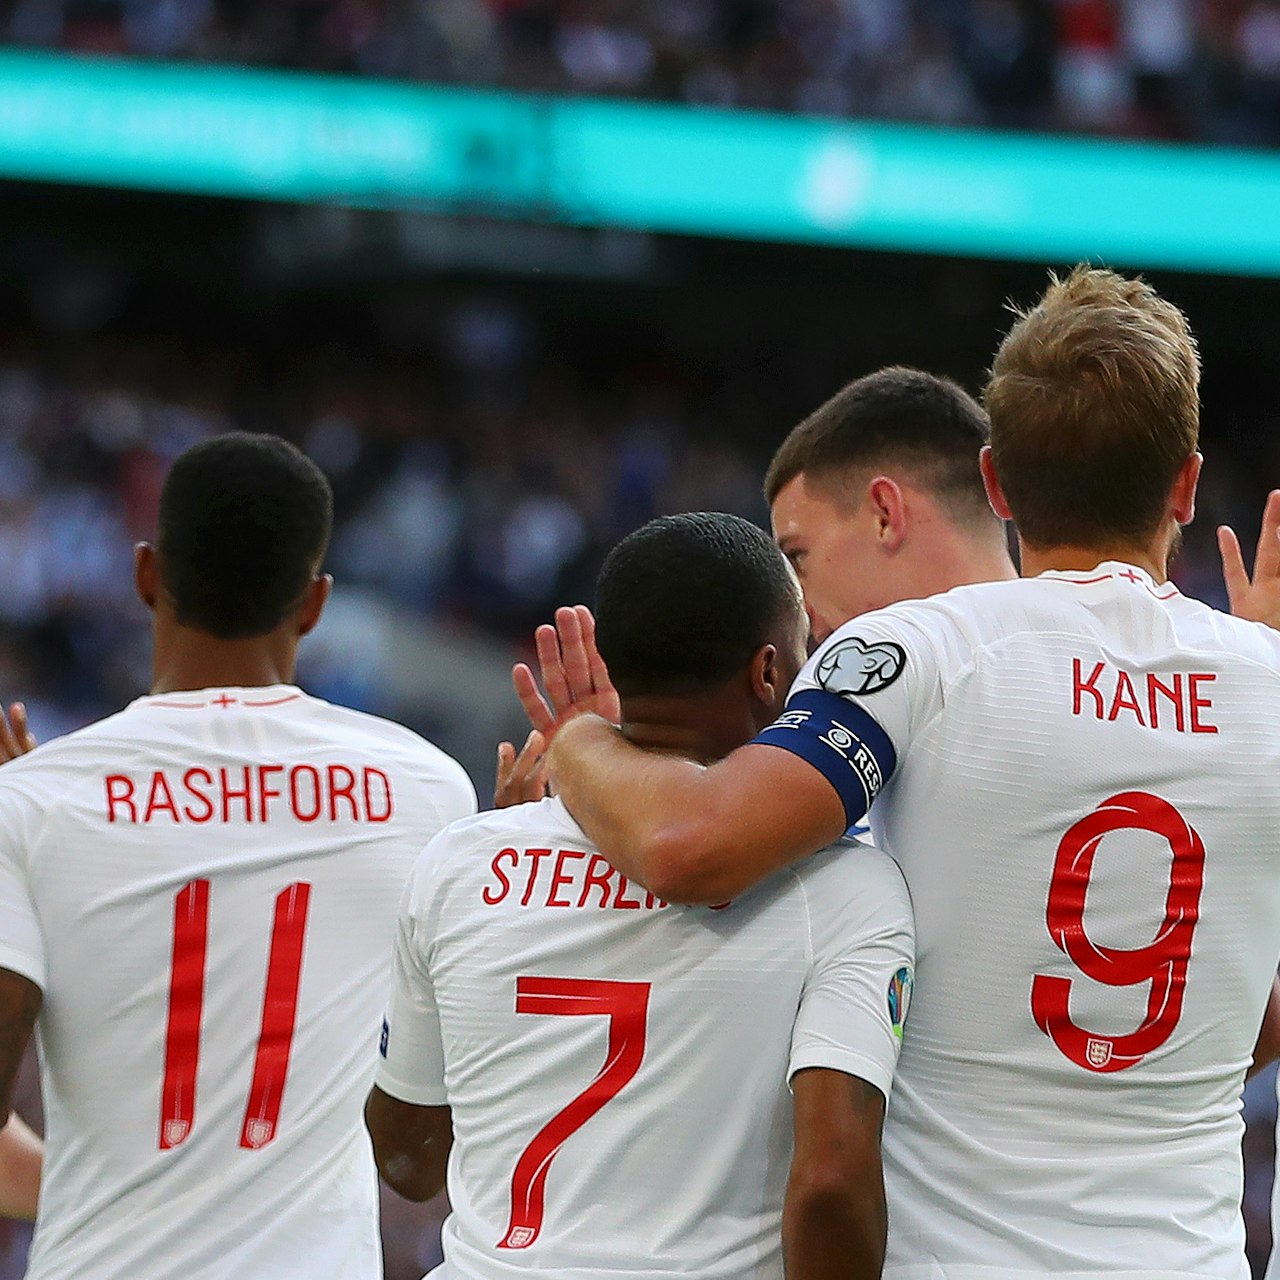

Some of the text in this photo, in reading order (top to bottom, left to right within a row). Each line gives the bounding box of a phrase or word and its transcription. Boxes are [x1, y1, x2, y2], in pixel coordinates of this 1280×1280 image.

[1072, 657, 1218, 735] KANE
[105, 764, 393, 824] RASHFORD
[482, 847, 732, 910] STERL
[158, 877, 313, 1151] 11
[1030, 791, 1206, 1073] 9
[496, 976, 651, 1248] 7
